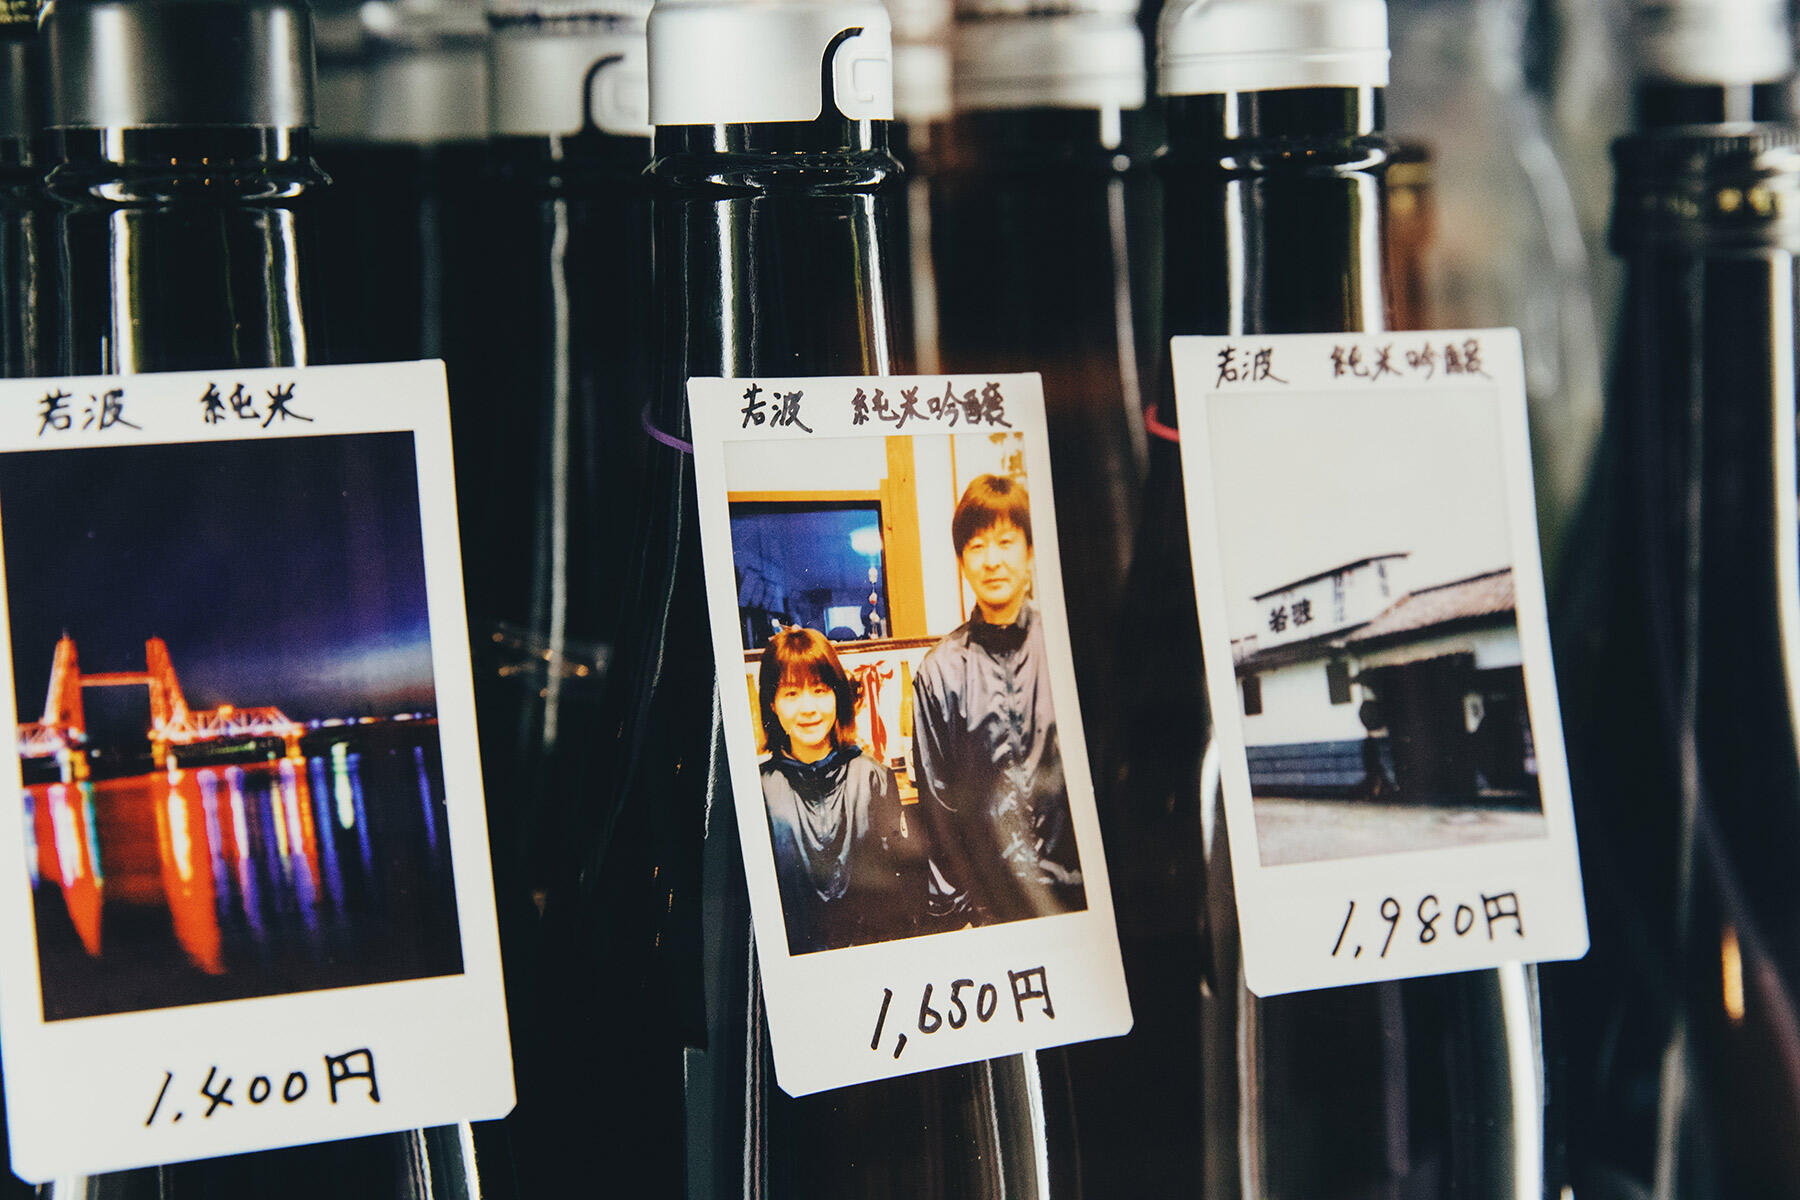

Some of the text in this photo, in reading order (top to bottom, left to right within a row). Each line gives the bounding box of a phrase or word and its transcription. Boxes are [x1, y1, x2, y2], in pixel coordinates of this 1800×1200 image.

[1215, 345, 1289, 390] 若波
[38, 382, 314, 436] 若波 純米
[740, 380, 1013, 433] 若波 純米吟醸
[870, 965, 1056, 1060] 1,650円
